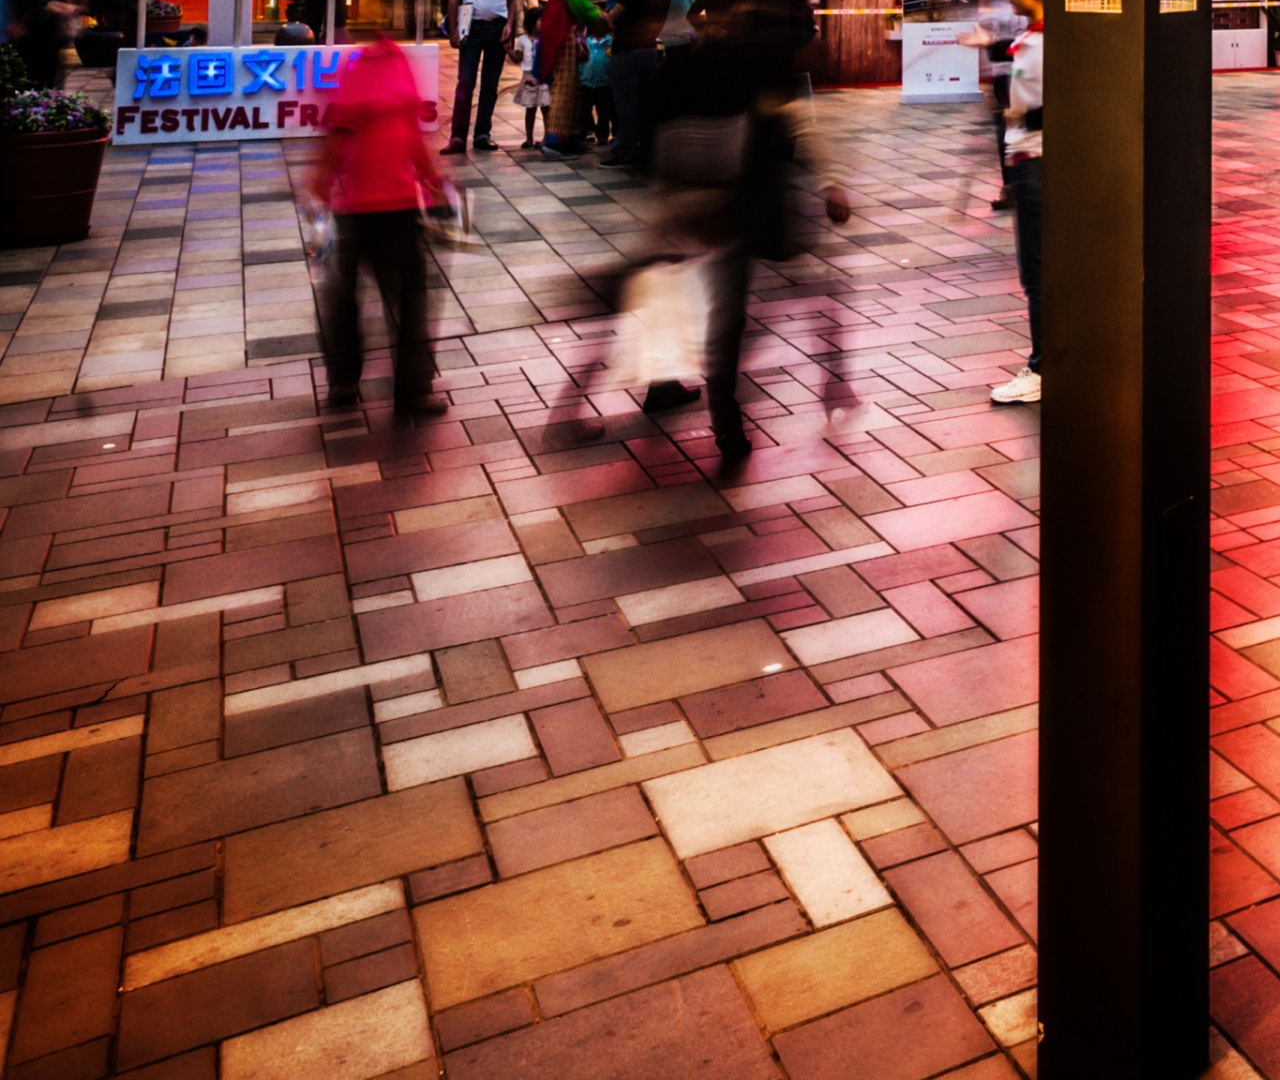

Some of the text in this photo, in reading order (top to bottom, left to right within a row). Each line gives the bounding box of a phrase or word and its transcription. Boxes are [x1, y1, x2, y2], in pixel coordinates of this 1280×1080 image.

[132, 49, 360, 100] 法国文化
[115, 104, 270, 136] FESTIVAL
